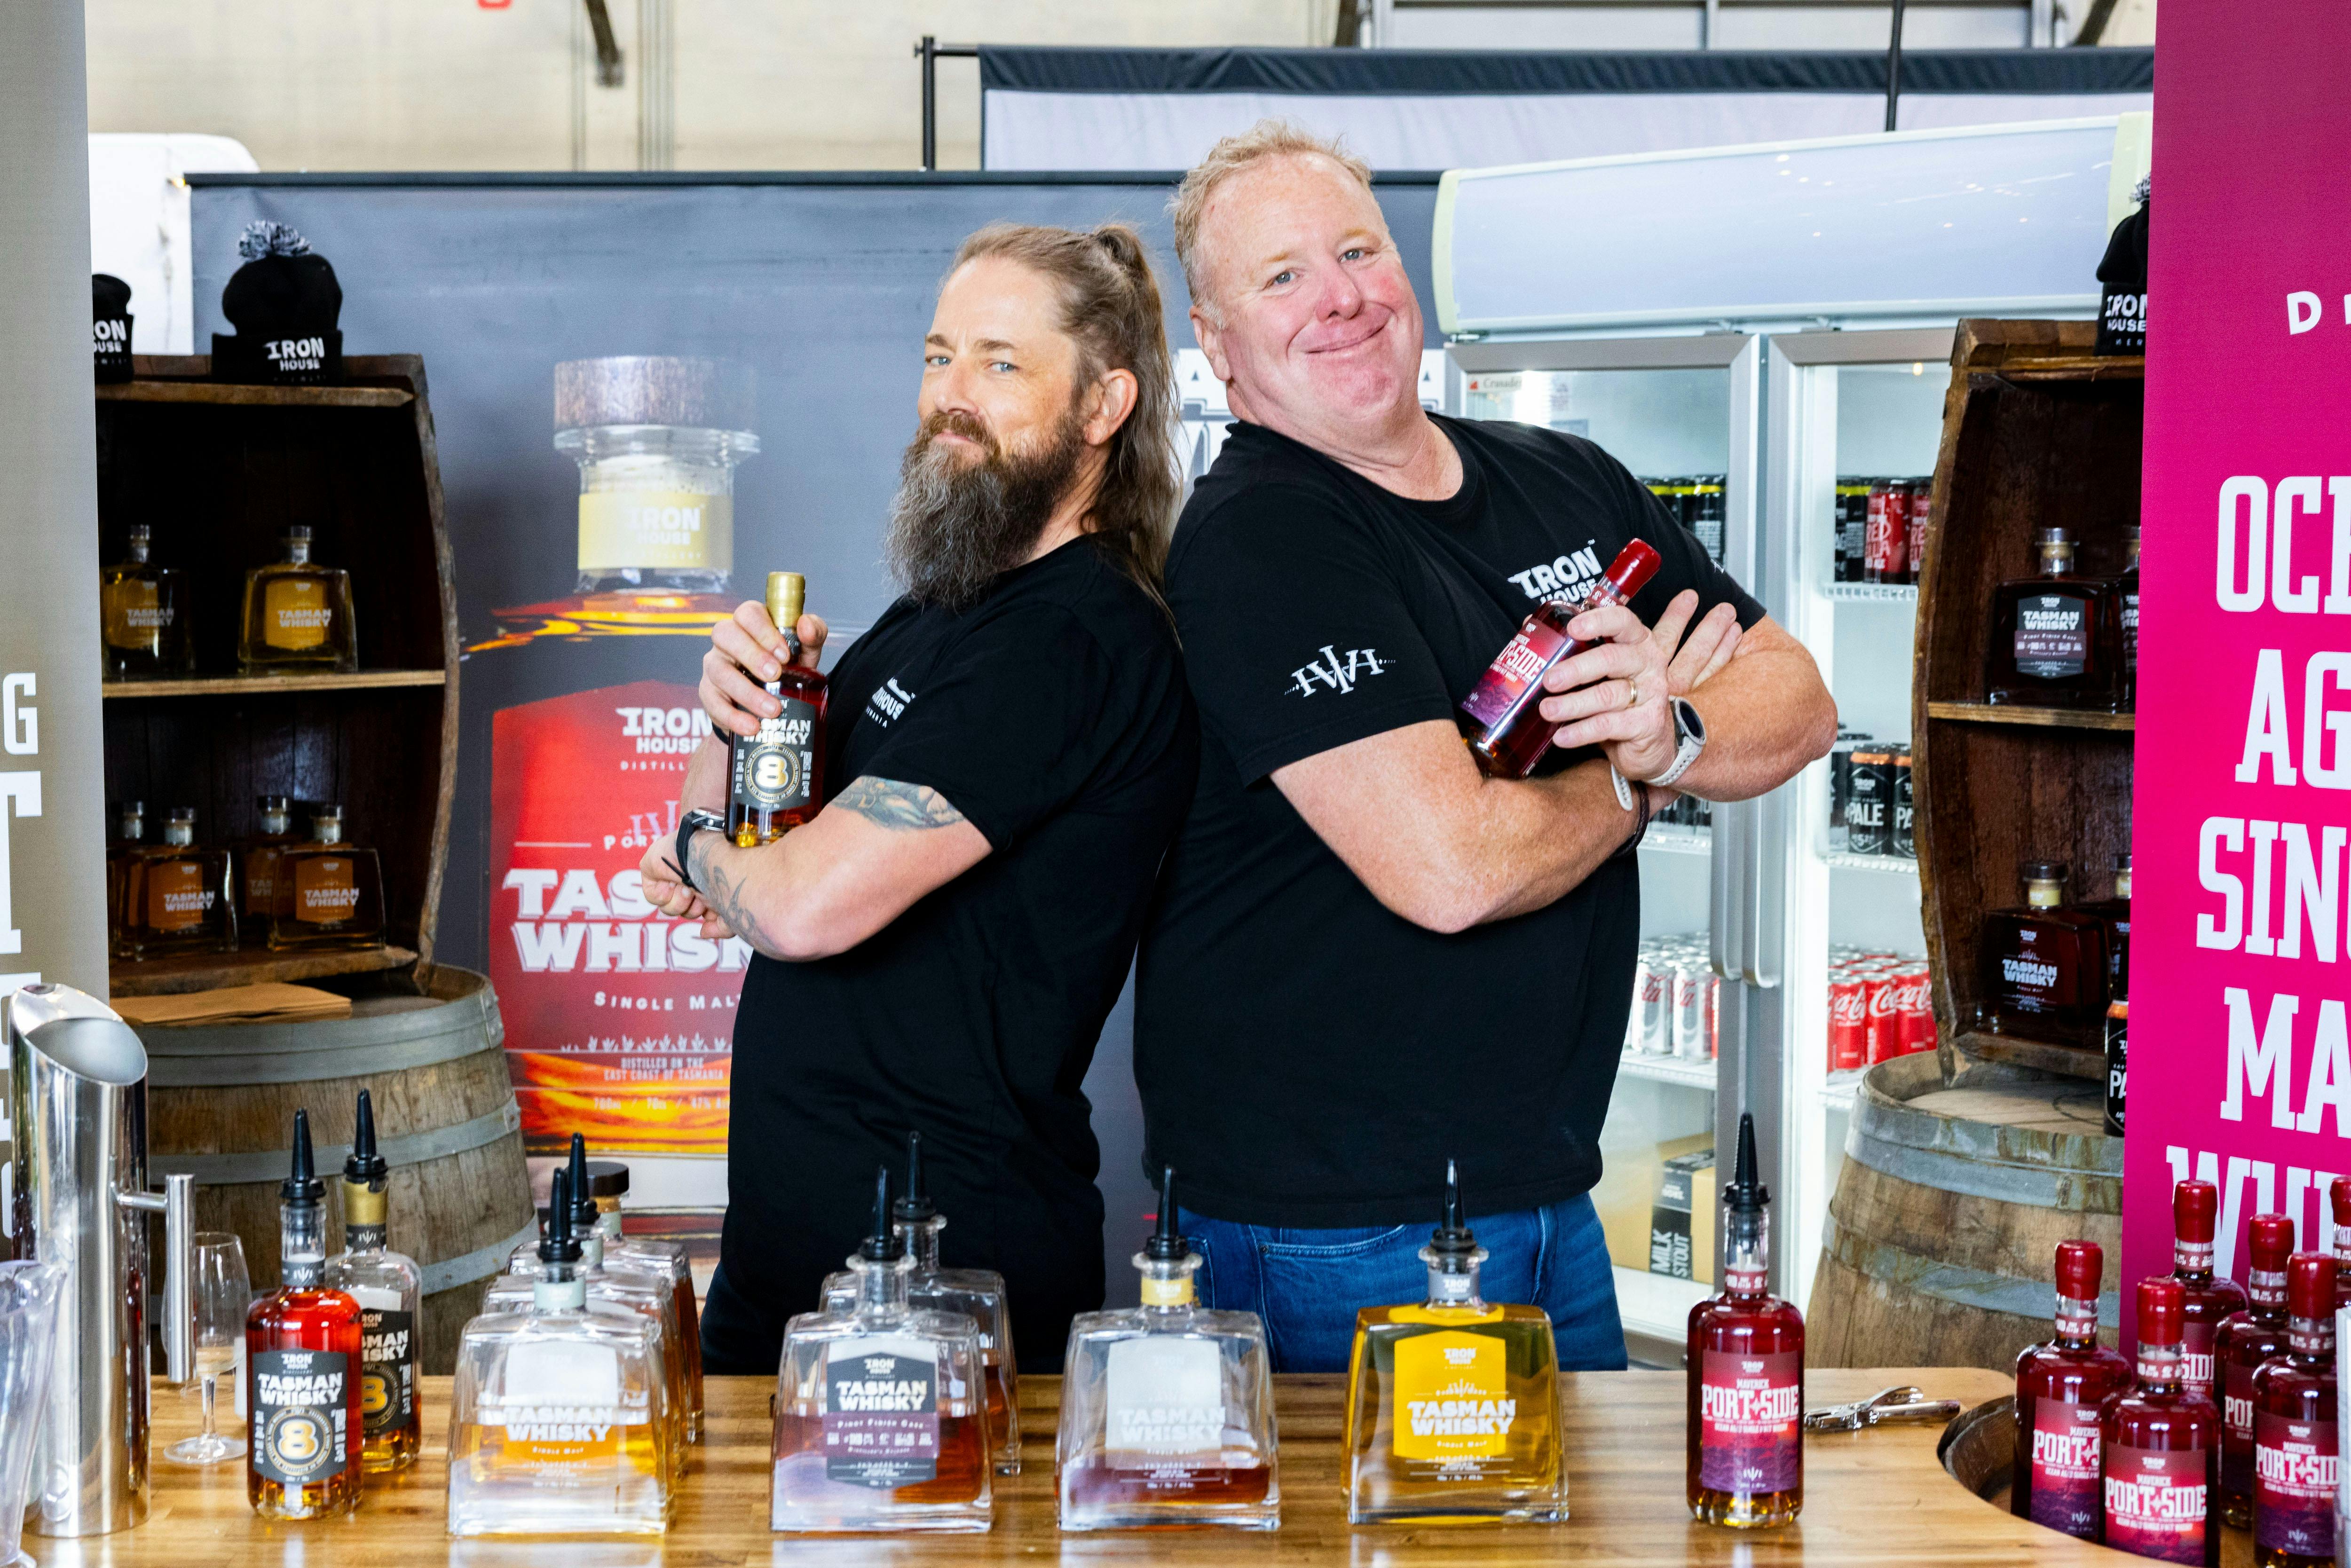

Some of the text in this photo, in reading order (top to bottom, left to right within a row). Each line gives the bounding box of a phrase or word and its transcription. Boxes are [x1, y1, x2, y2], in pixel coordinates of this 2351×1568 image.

[94, 320, 127, 341] ON
[263, 337, 324, 360] IRON
[279, 358, 320, 371] HOUSE
[626, 506, 701, 531] IRON
[637, 531, 691, 545] HOUSE
[1507, 546, 1602, 599] IRON
[278, 609, 331, 618] TASMAN
[2023, 611, 2079, 621] TASMAN
[2024, 620, 2079, 630] WHISKY
[616, 707, 712, 737] IRON
[760, 718, 811, 732] SMAN
[755, 754, 789, 789] 8
[1849, 802, 1885, 826] PALE
[164, 890, 214, 901] TASMAN
[305, 888, 359, 899] TASMAN
[502, 868, 677, 920] TAS
[2197, 816, 2351, 963] SIN
[166, 900, 213, 912] WHISKY
[307, 897, 358, 908] WHISKY
[2002, 959, 2058, 977] TASMAN
[2004, 970, 2056, 987] WHISKY
[594, 992, 674, 1010] SINGLE
[1651, 1229, 1673, 1273] MILK
[1672, 1232, 1690, 1277] STOUT
[362, 1314, 382, 1323] RON
[282, 1353, 314, 1364] IRON
[362, 1343, 407, 1362] ISKY
[1444, 1348, 1476, 1359] IRON
[864, 1358, 895, 1369] IRON
[258, 1372, 343, 1391] TASMAN
[836, 1380, 927, 1396] TASMAN
[259, 1387, 341, 1405] WHISKY
[838, 1395, 926, 1411] WHISKY
[1701, 1384, 1799, 1420] PORT SIDE
[503, 1406, 613, 1423] TASMAN
[1117, 1406, 1226, 1424] TASMAN
[1407, 1399, 1516, 1418] TASMAN
[506, 1424, 612, 1442] WHISKY
[1120, 1424, 1224, 1442] WHISKY
[1411, 1417, 1515, 1436] WHISKY
[277, 1418, 319, 1459] 8
[2032, 1429, 2087, 1466] PORT
[2256, 1443, 2339, 1485] PORT SID
[2105, 1476, 2207, 1519] PORT SIDE
